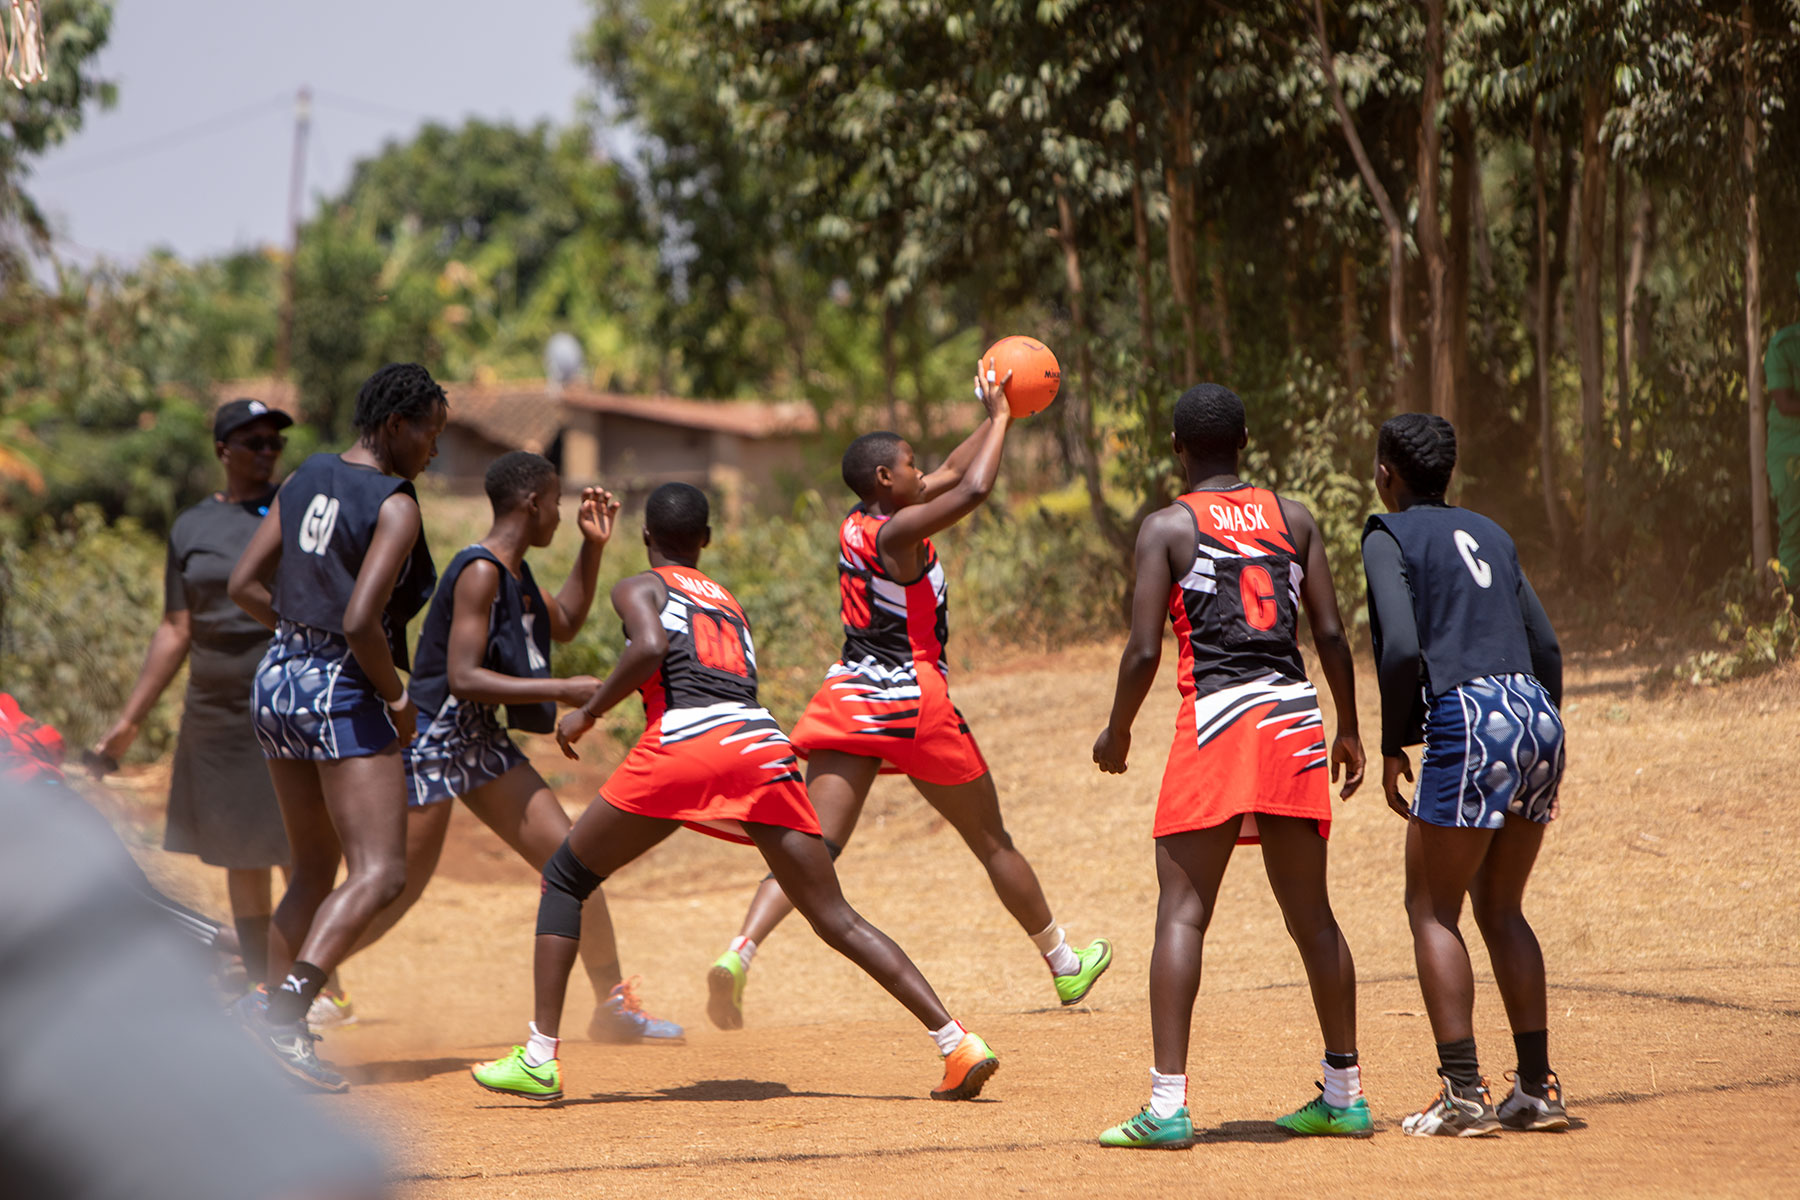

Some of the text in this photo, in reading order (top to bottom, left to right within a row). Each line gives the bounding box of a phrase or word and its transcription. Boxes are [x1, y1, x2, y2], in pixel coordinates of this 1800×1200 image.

[1209, 503, 1270, 532] SMASK
[1453, 529, 1492, 589] C
[672, 572, 729, 601] SMASK
[1239, 565, 1277, 632] C
